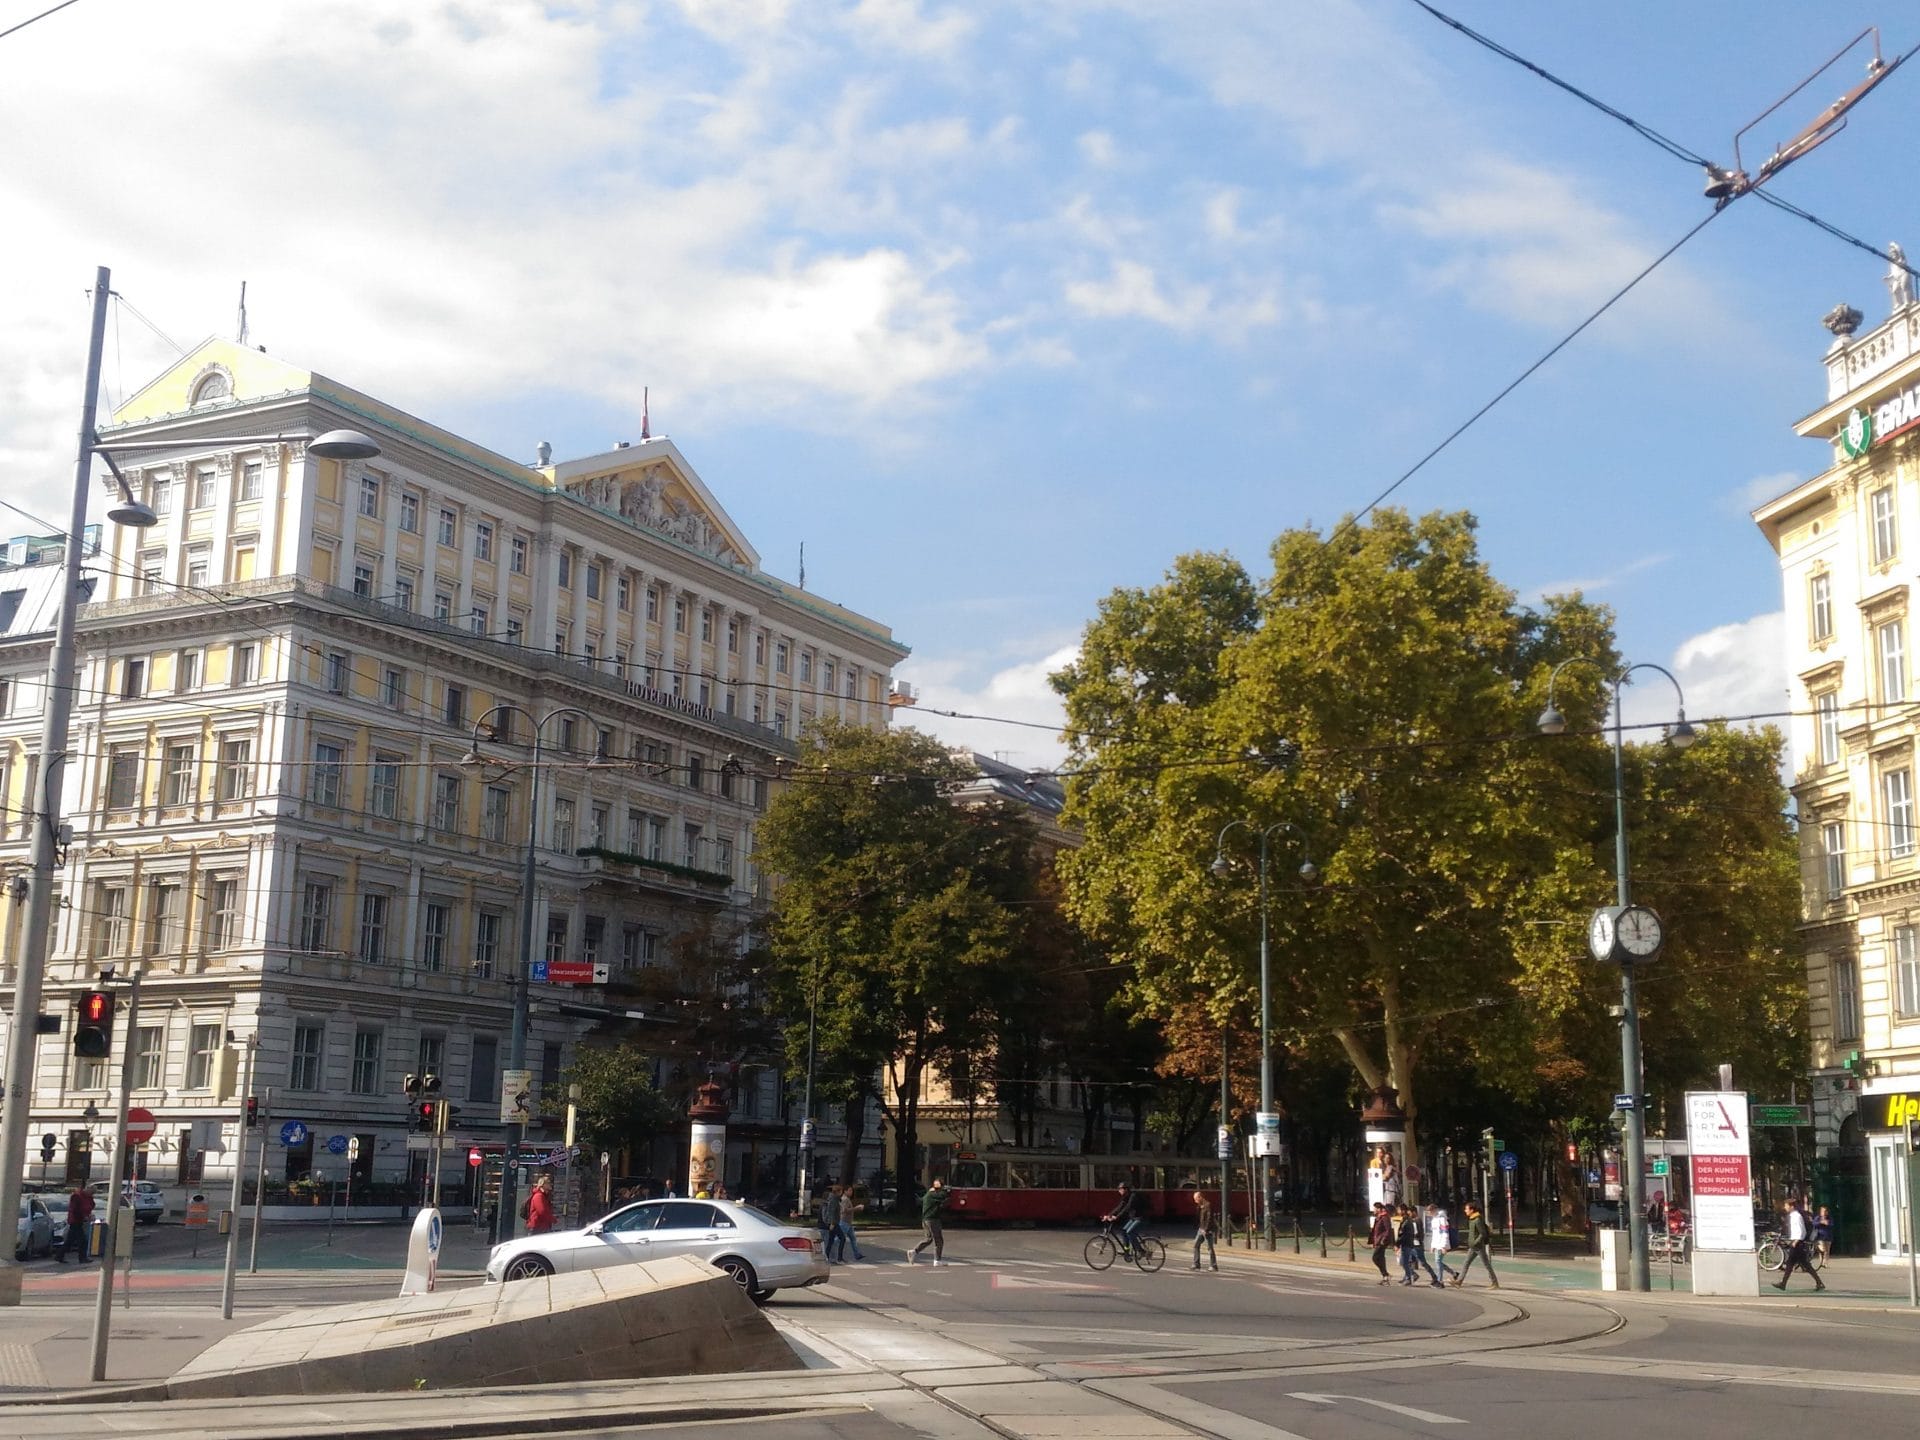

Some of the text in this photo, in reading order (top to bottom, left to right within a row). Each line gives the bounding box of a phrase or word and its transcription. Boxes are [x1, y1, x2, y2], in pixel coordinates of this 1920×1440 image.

[1876, 386, 1920, 437] GRA
[627, 680, 716, 721] HOTEL IMPERIAL
[1694, 1111, 1715, 1119] FOR
[1887, 1094, 1920, 1127] He
